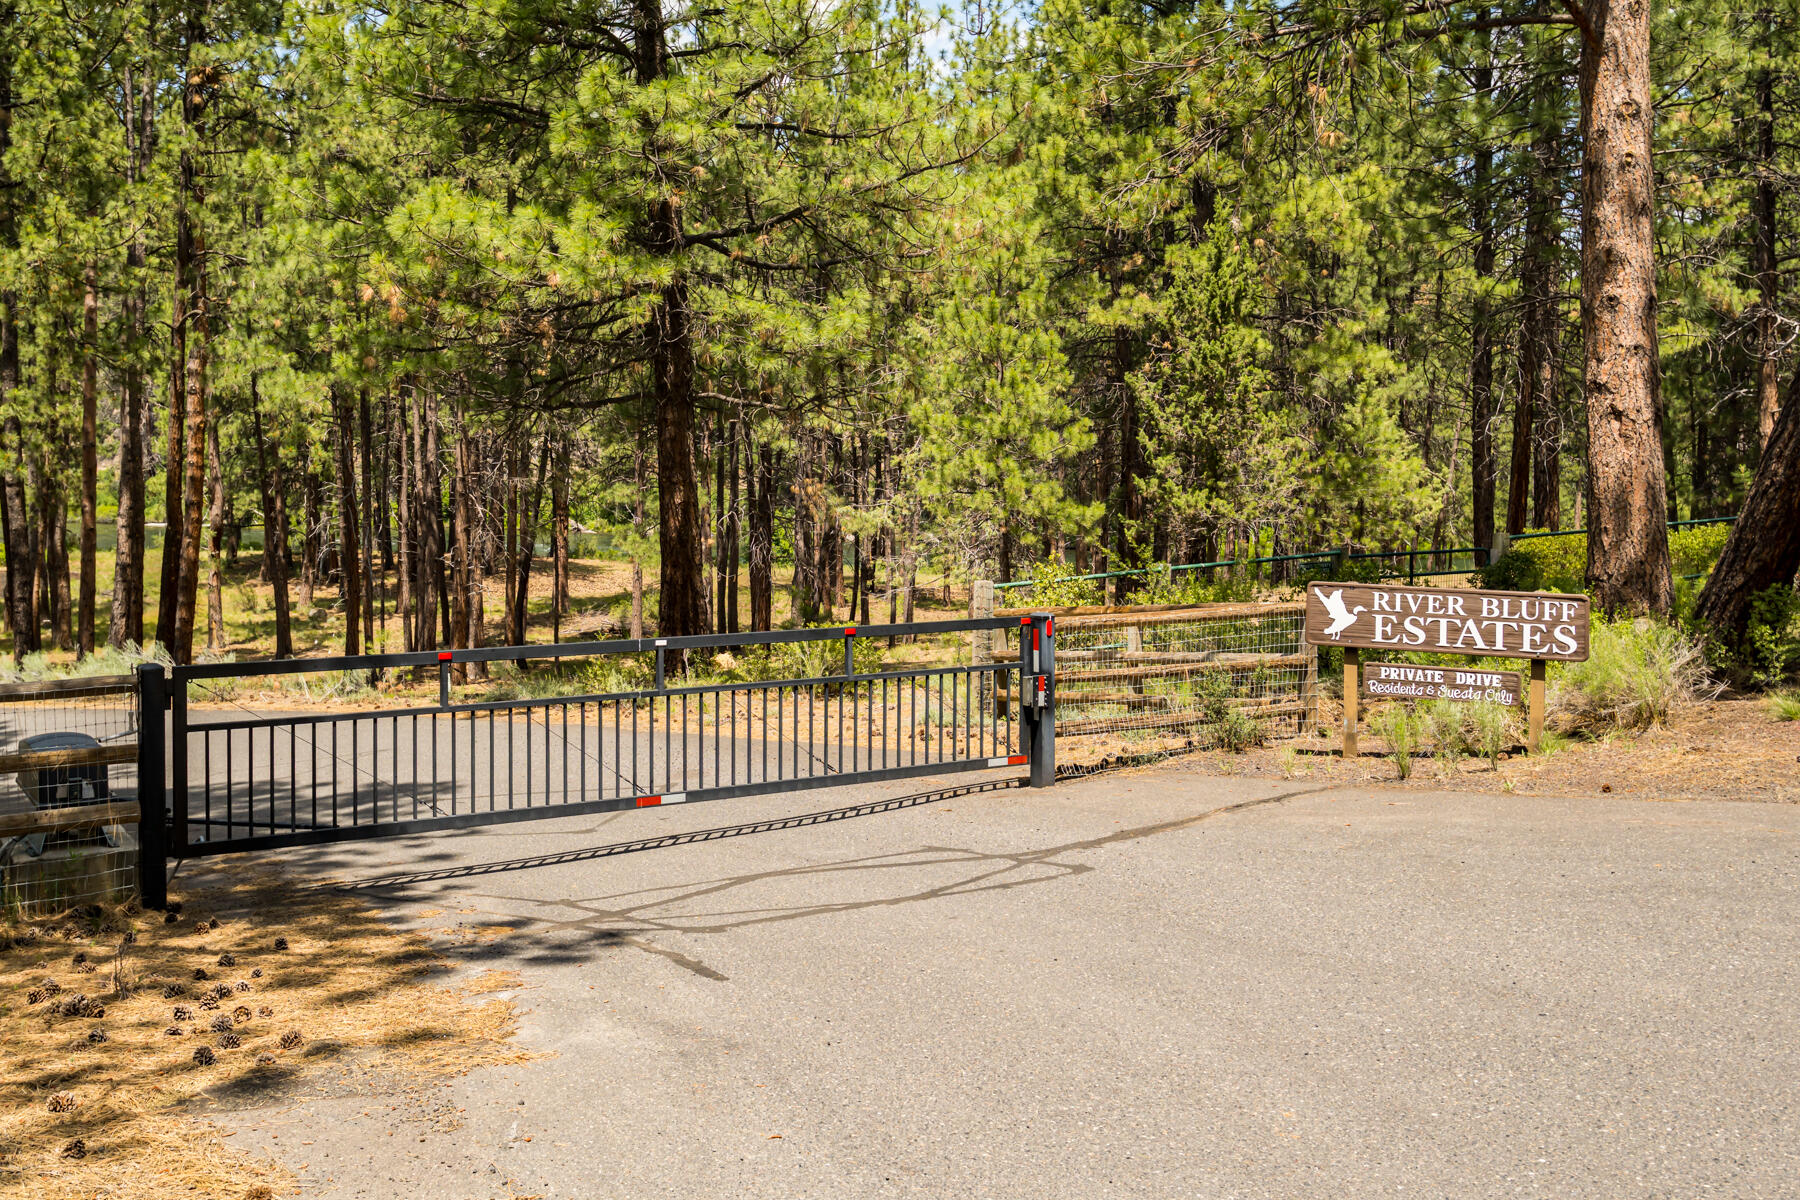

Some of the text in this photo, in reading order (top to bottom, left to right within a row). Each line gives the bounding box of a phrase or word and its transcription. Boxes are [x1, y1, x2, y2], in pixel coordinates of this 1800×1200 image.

[1372, 591, 1578, 622] RIVER BLUFF
[1371, 614, 1579, 655] ESTATES
[1380, 667, 1502, 687] PRIVATE DRIVE
[1368, 680, 1512, 705] Residents & Guests Only
